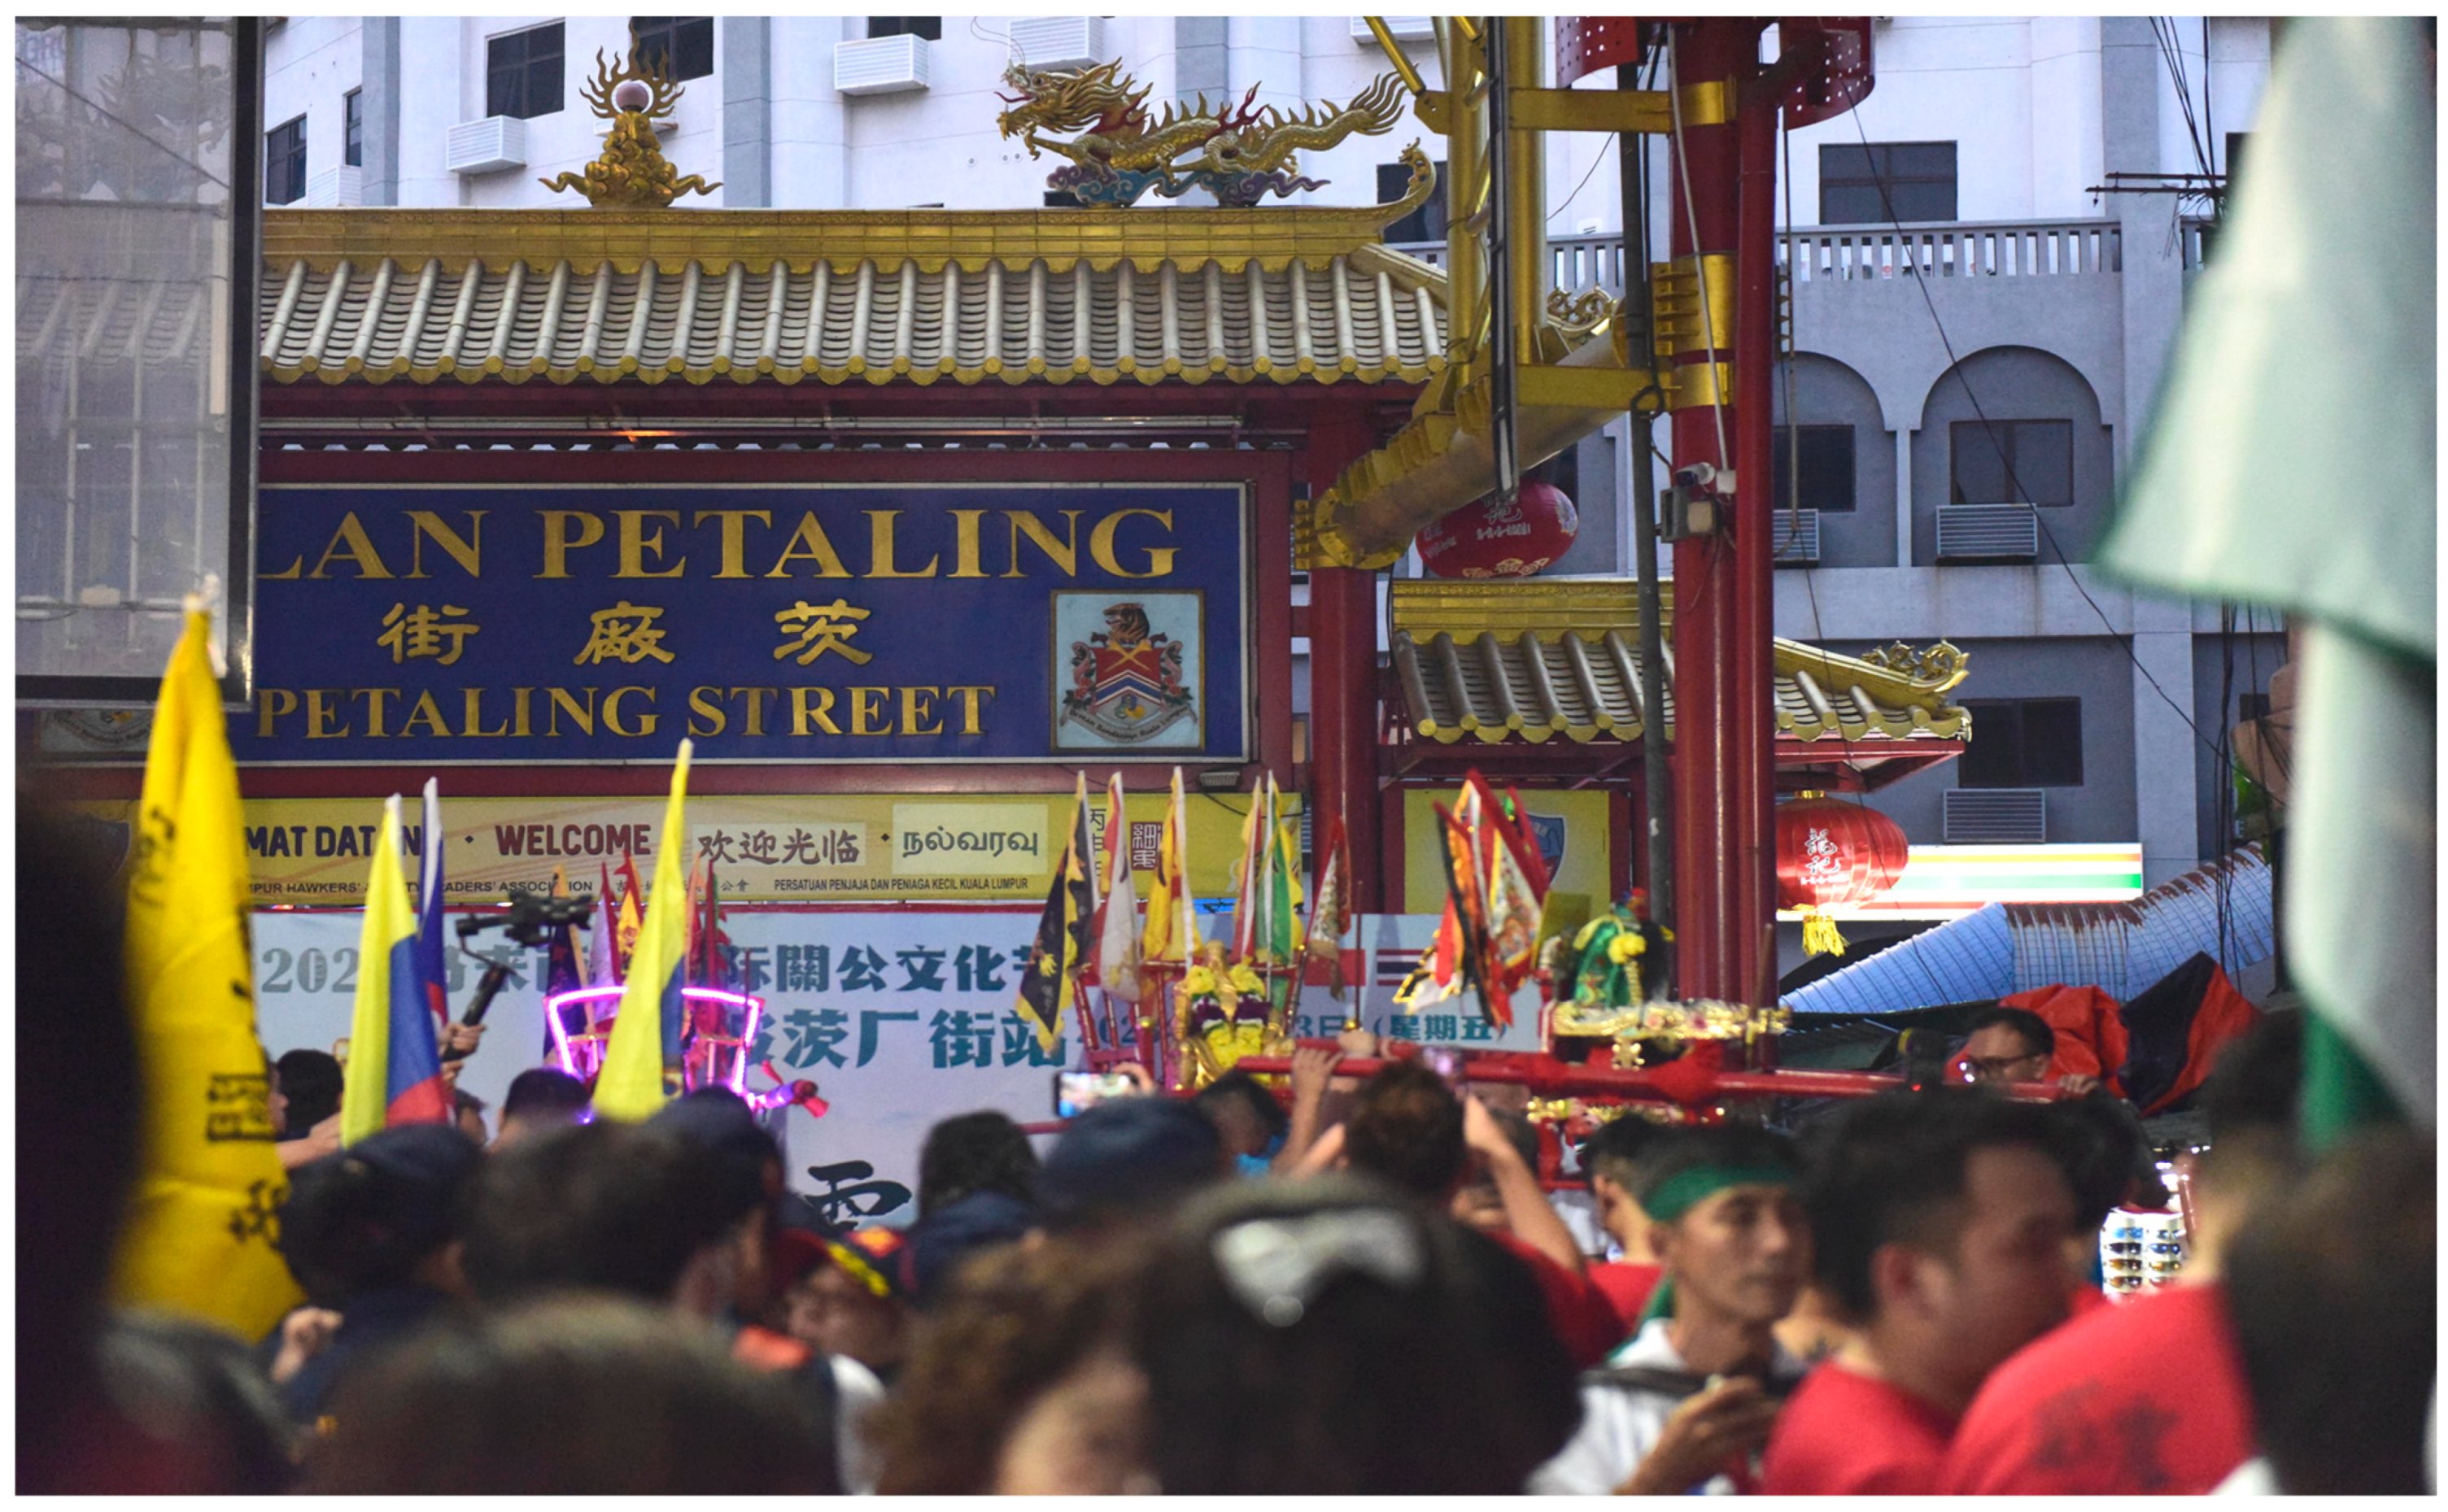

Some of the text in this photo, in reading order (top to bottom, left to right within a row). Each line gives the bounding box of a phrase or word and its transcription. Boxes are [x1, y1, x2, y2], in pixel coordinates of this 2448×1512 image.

[533, 507, 1181, 580] PETALING
[255, 684, 996, 740] PETALING STREET
[495, 824, 652, 856] WELCOME
[697, 827, 861, 865] 欢迎光临
[902, 825, 1039, 858] நல்வரவு
[286, 882, 360, 893] HAWKERS'
[774, 878, 1028, 891] PERSATUAN PENJAJA DAN PENIAGA KECIL KUALA LUMPUR
